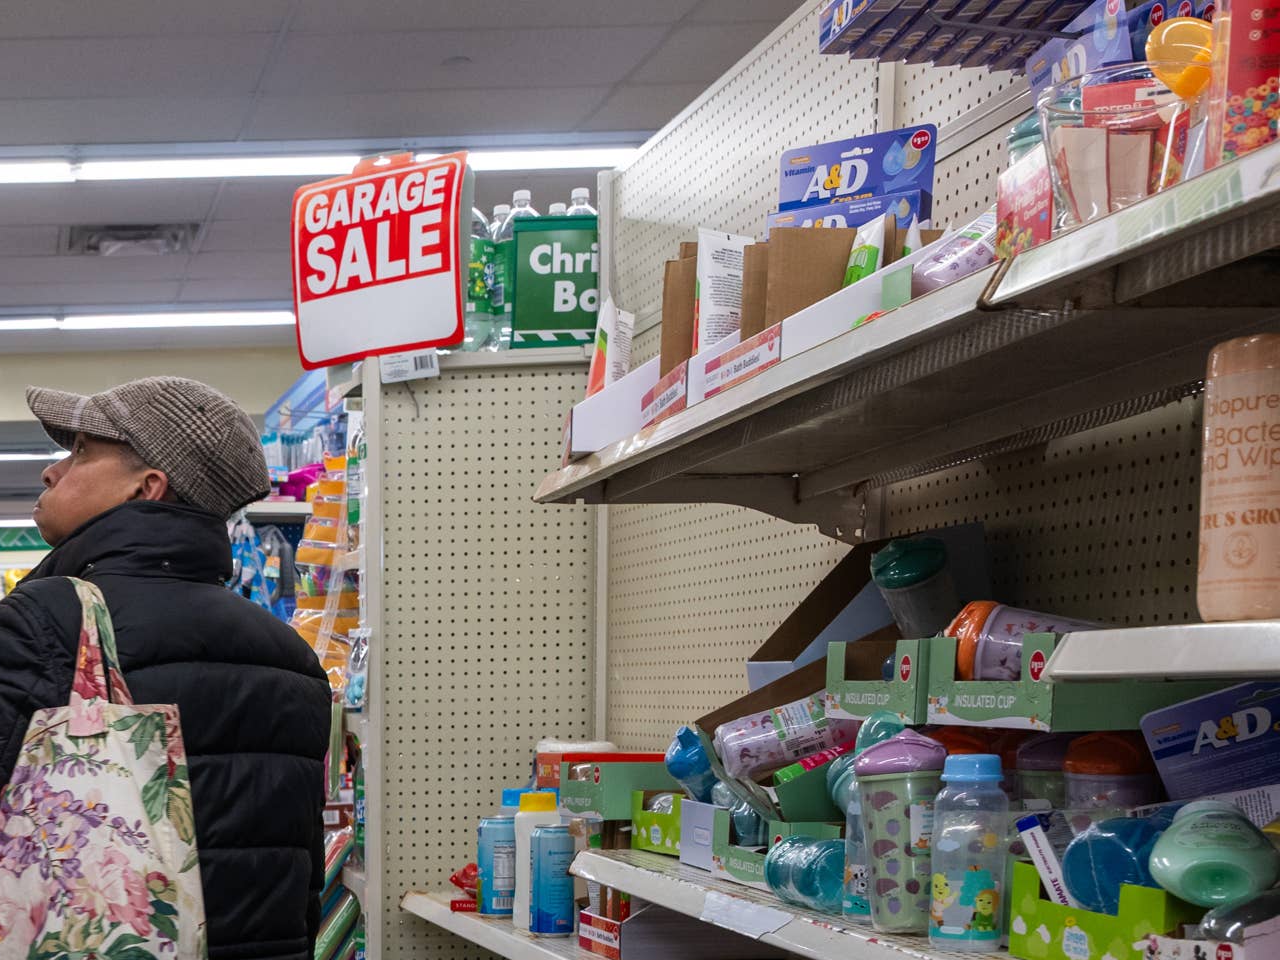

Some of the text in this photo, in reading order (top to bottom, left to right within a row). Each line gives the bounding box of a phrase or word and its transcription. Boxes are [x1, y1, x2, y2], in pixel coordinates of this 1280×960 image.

[304, 166, 449, 235] GARAGE
[801, 158, 869, 203] A&D
[306, 208, 443, 296] SALE
[1191, 706, 1272, 756] A&D
